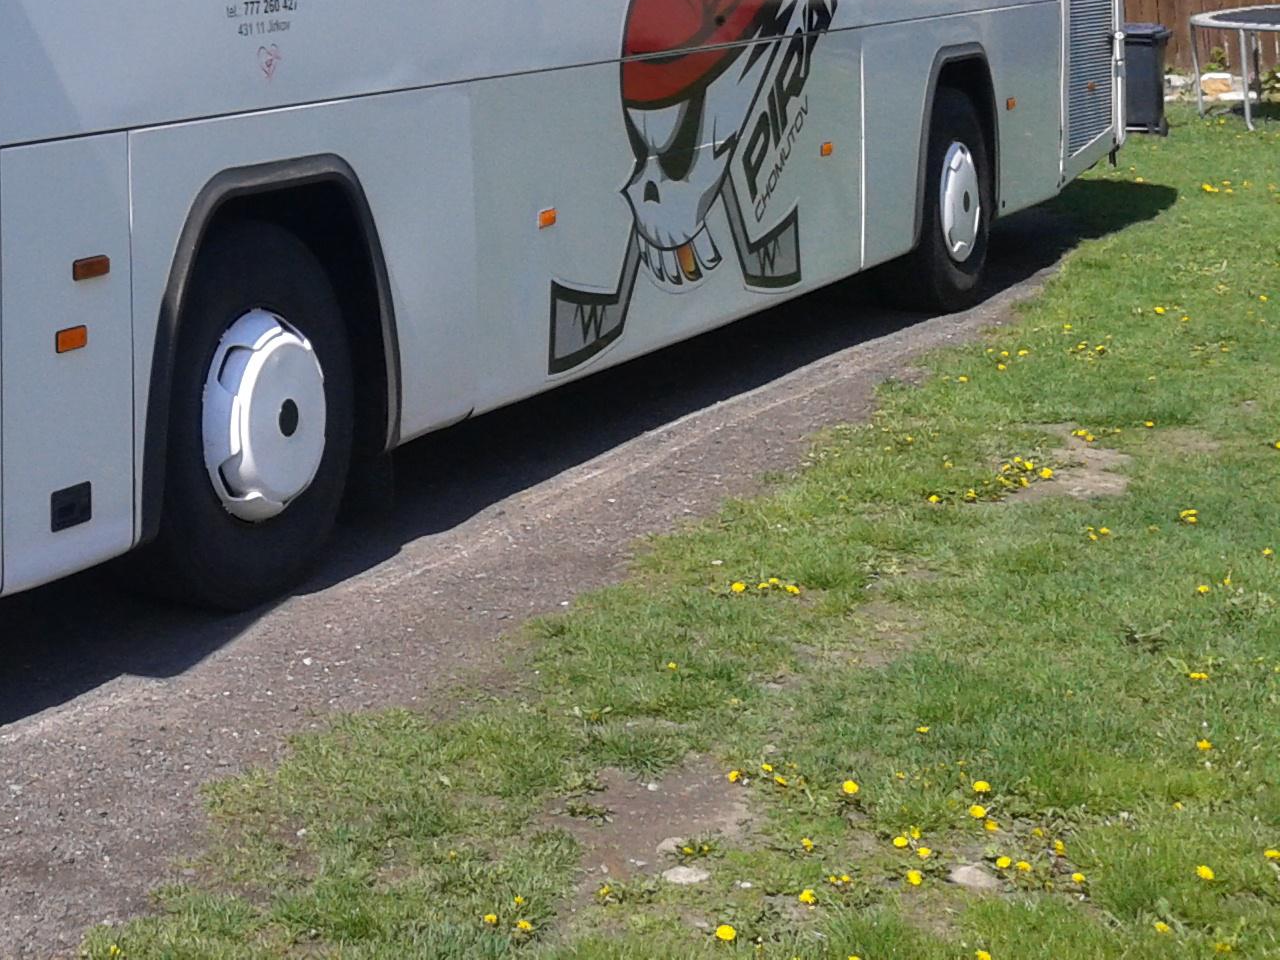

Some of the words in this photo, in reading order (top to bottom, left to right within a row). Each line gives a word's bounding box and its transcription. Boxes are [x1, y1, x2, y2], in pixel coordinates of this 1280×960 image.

[243, 0, 260, 15] 777
[237, 22, 252, 36] 431
[255, 21, 264, 34] 11
[754, 95, 809, 223] CHOMUTOV
